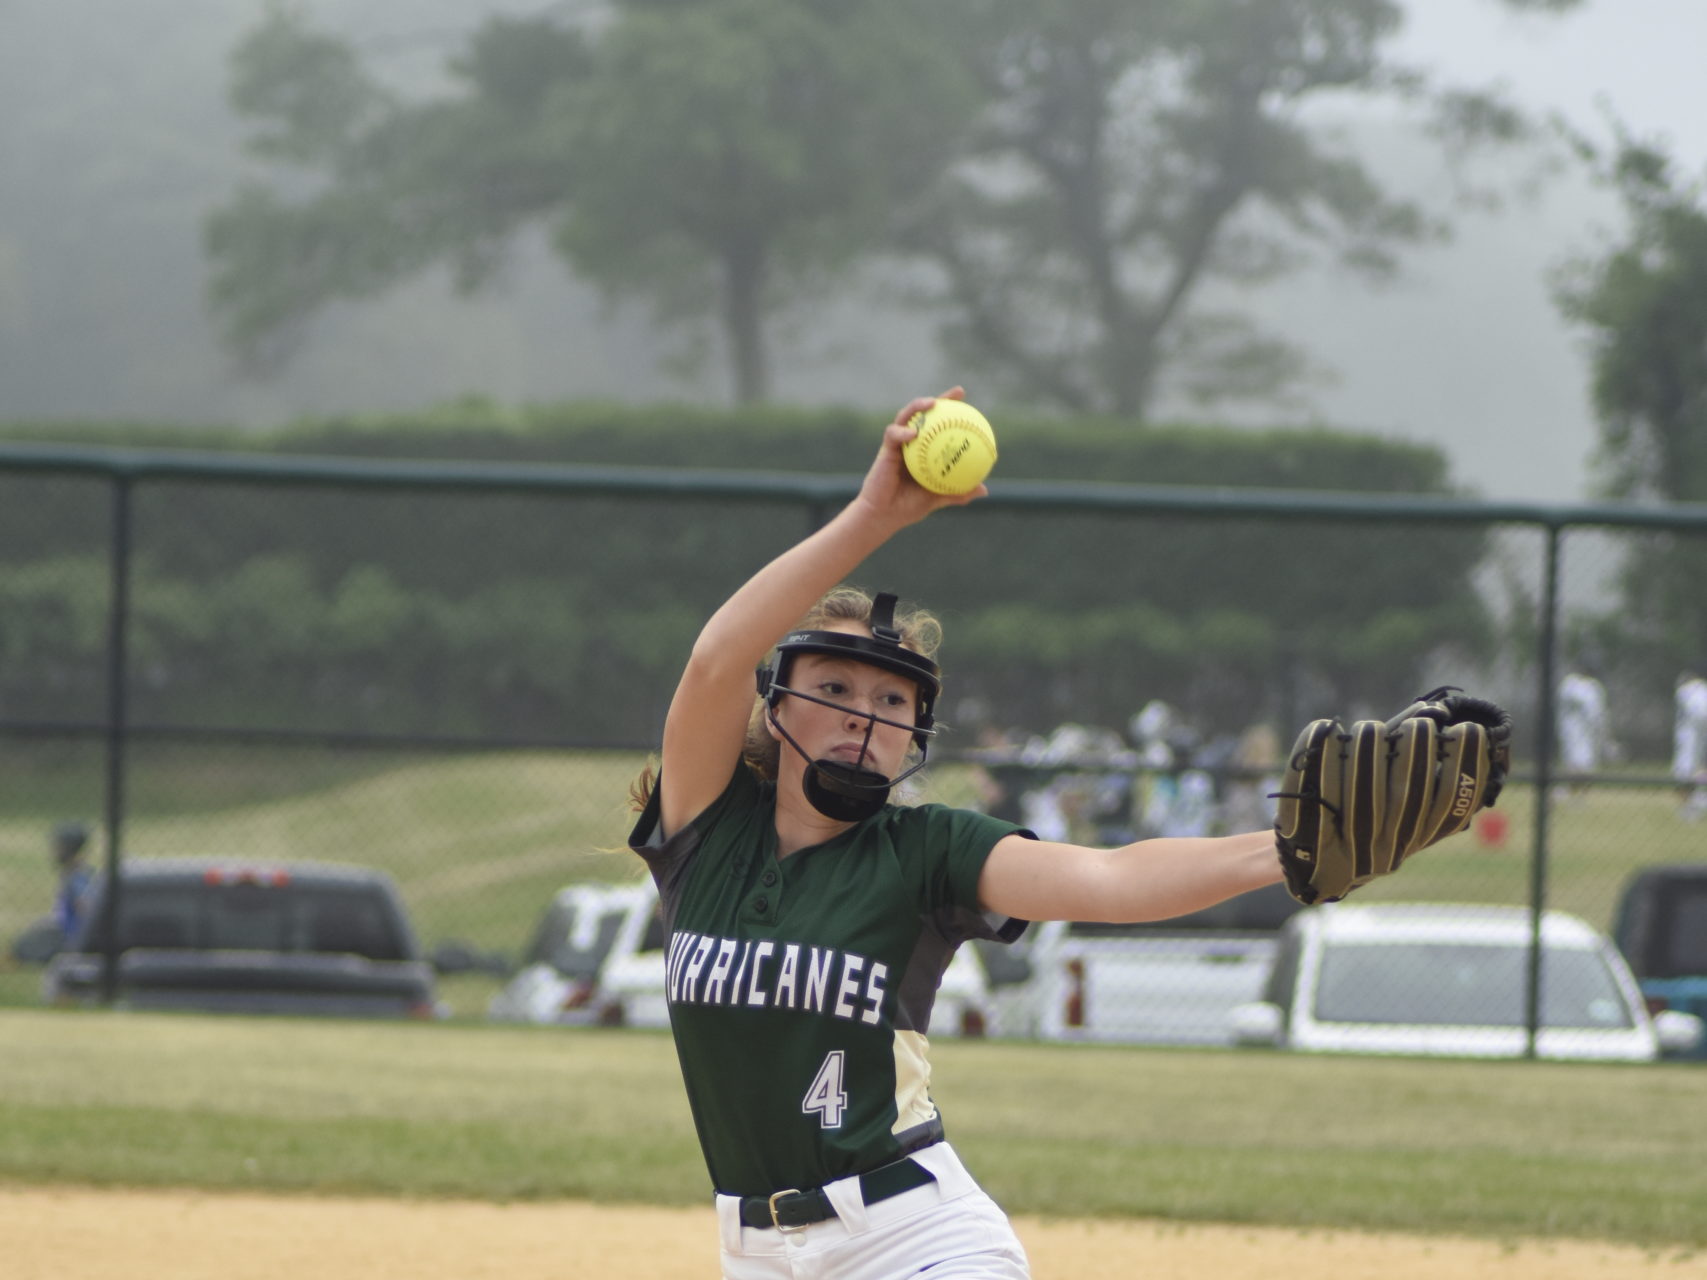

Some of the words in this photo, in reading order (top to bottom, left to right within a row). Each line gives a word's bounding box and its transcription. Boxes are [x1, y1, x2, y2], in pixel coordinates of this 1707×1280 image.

[1452, 772, 1475, 817] A500
[666, 931, 888, 1025] HURRICANES
[802, 1050, 848, 1129] 4
